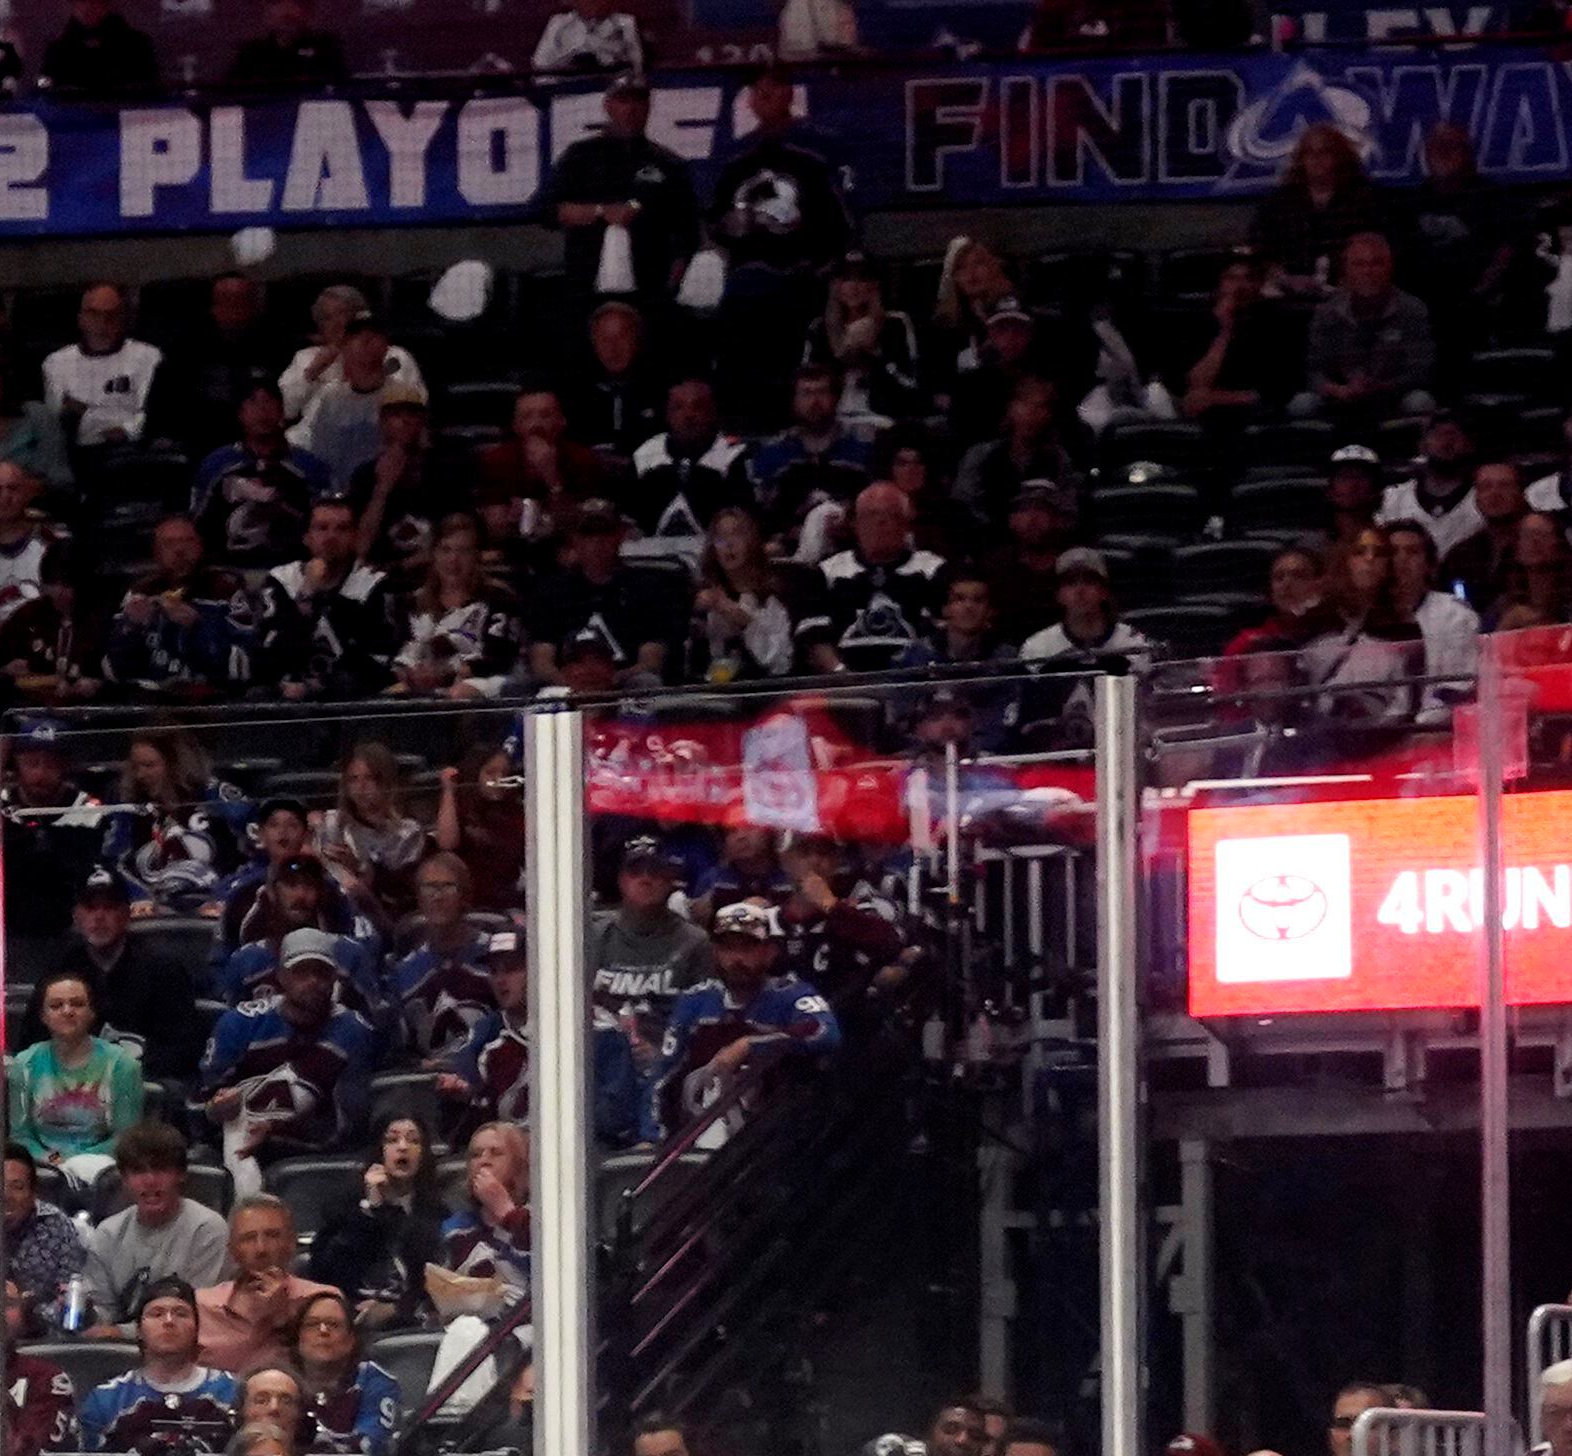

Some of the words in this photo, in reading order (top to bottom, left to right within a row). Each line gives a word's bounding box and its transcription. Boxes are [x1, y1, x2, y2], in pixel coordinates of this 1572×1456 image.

[119, 84, 809, 218] PLAYOF
[904, 70, 1244, 192] FIND
[593, 968, 678, 995] FINAL
